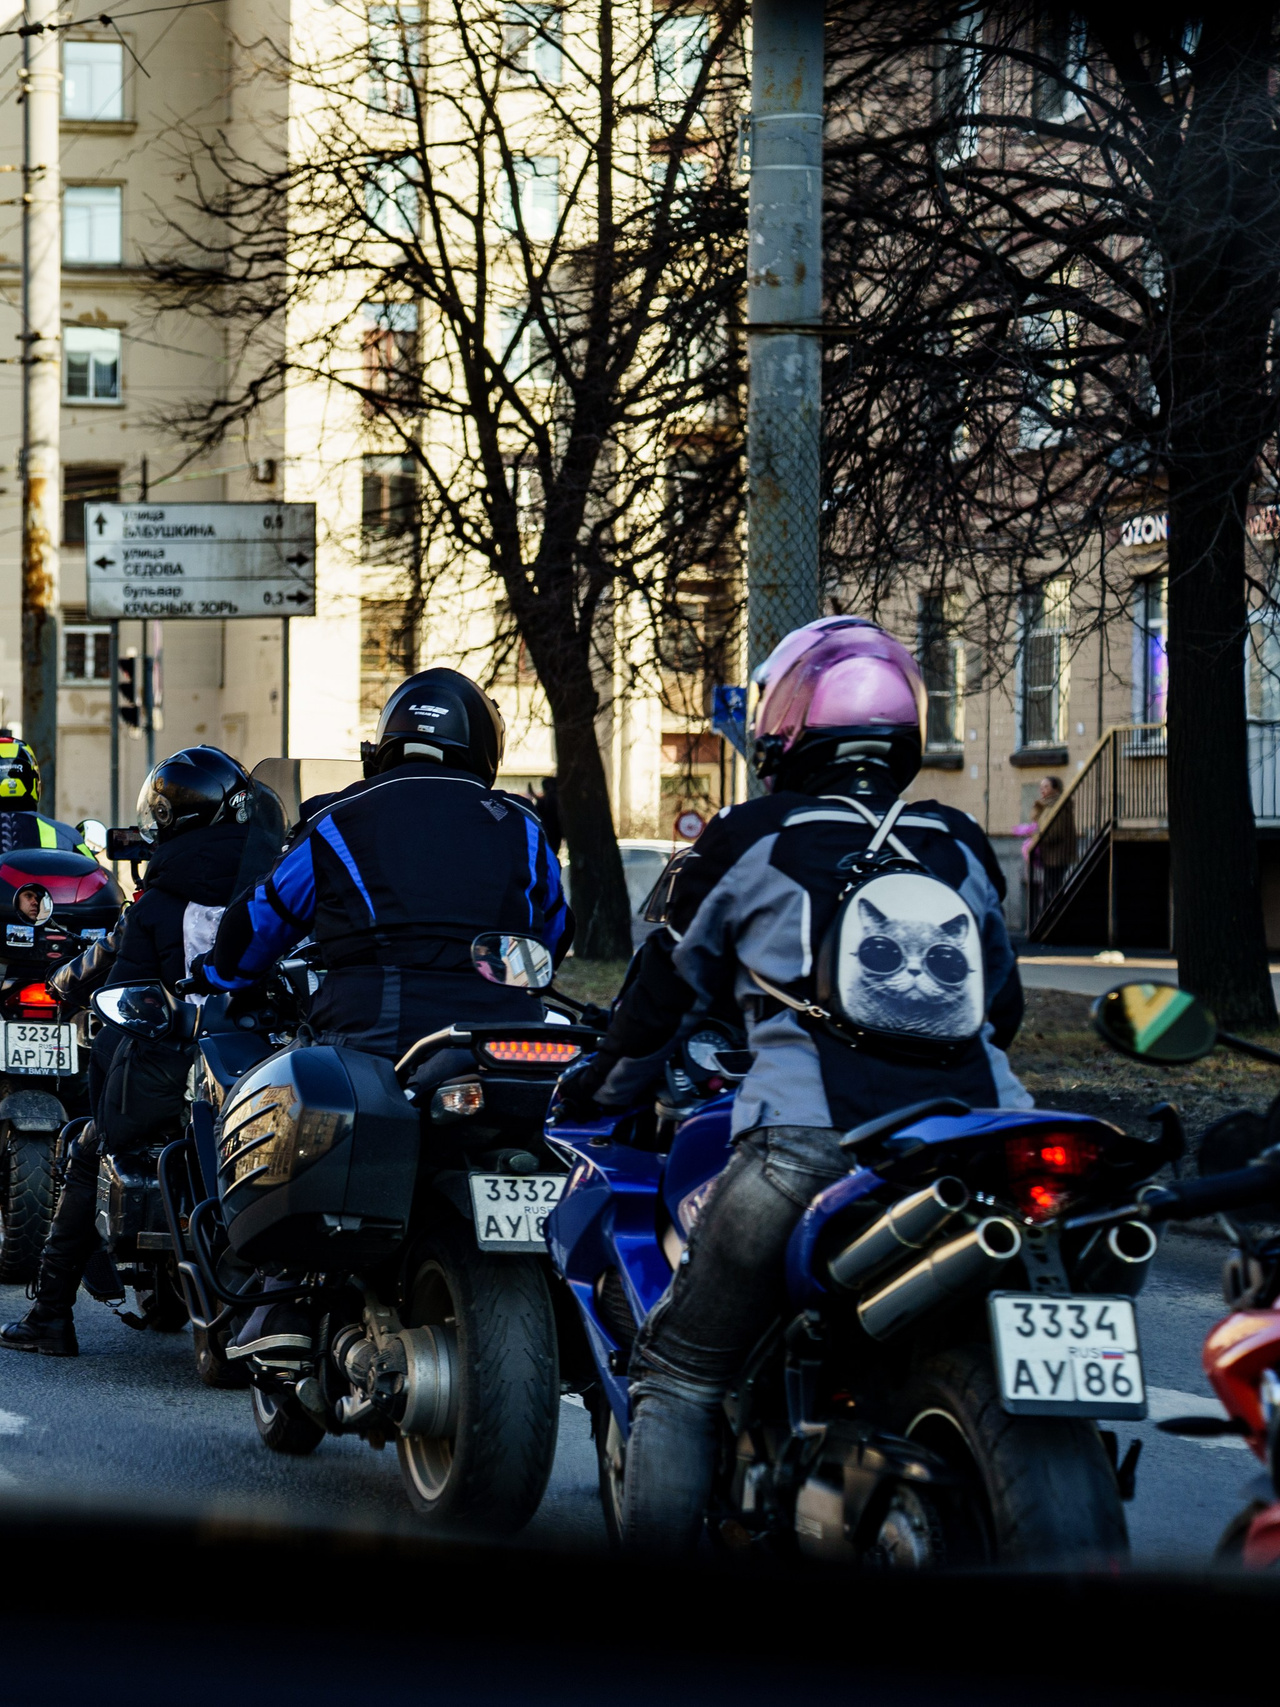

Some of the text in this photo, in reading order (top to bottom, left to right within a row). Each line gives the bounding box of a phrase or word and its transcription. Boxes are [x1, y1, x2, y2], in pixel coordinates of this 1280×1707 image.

[1121, 513, 1168, 547] OZON
[122, 548, 165, 560] улица
[122, 562, 184, 577] СЕДОВА
[123, 583, 182, 599] бульвар
[123, 600, 239, 615] КРАСНЫХ ЗОРЬ
[17, 1025, 62, 1043] 3234
[45, 1050, 66, 1067] 78
[484, 1178, 560, 1202] 3332
[524, 1206, 548, 1215] RUS
[1013, 1302, 1118, 1341] 3334
[1068, 1346, 1101, 1360] RUS
[1084, 1362, 1133, 1398] 86
